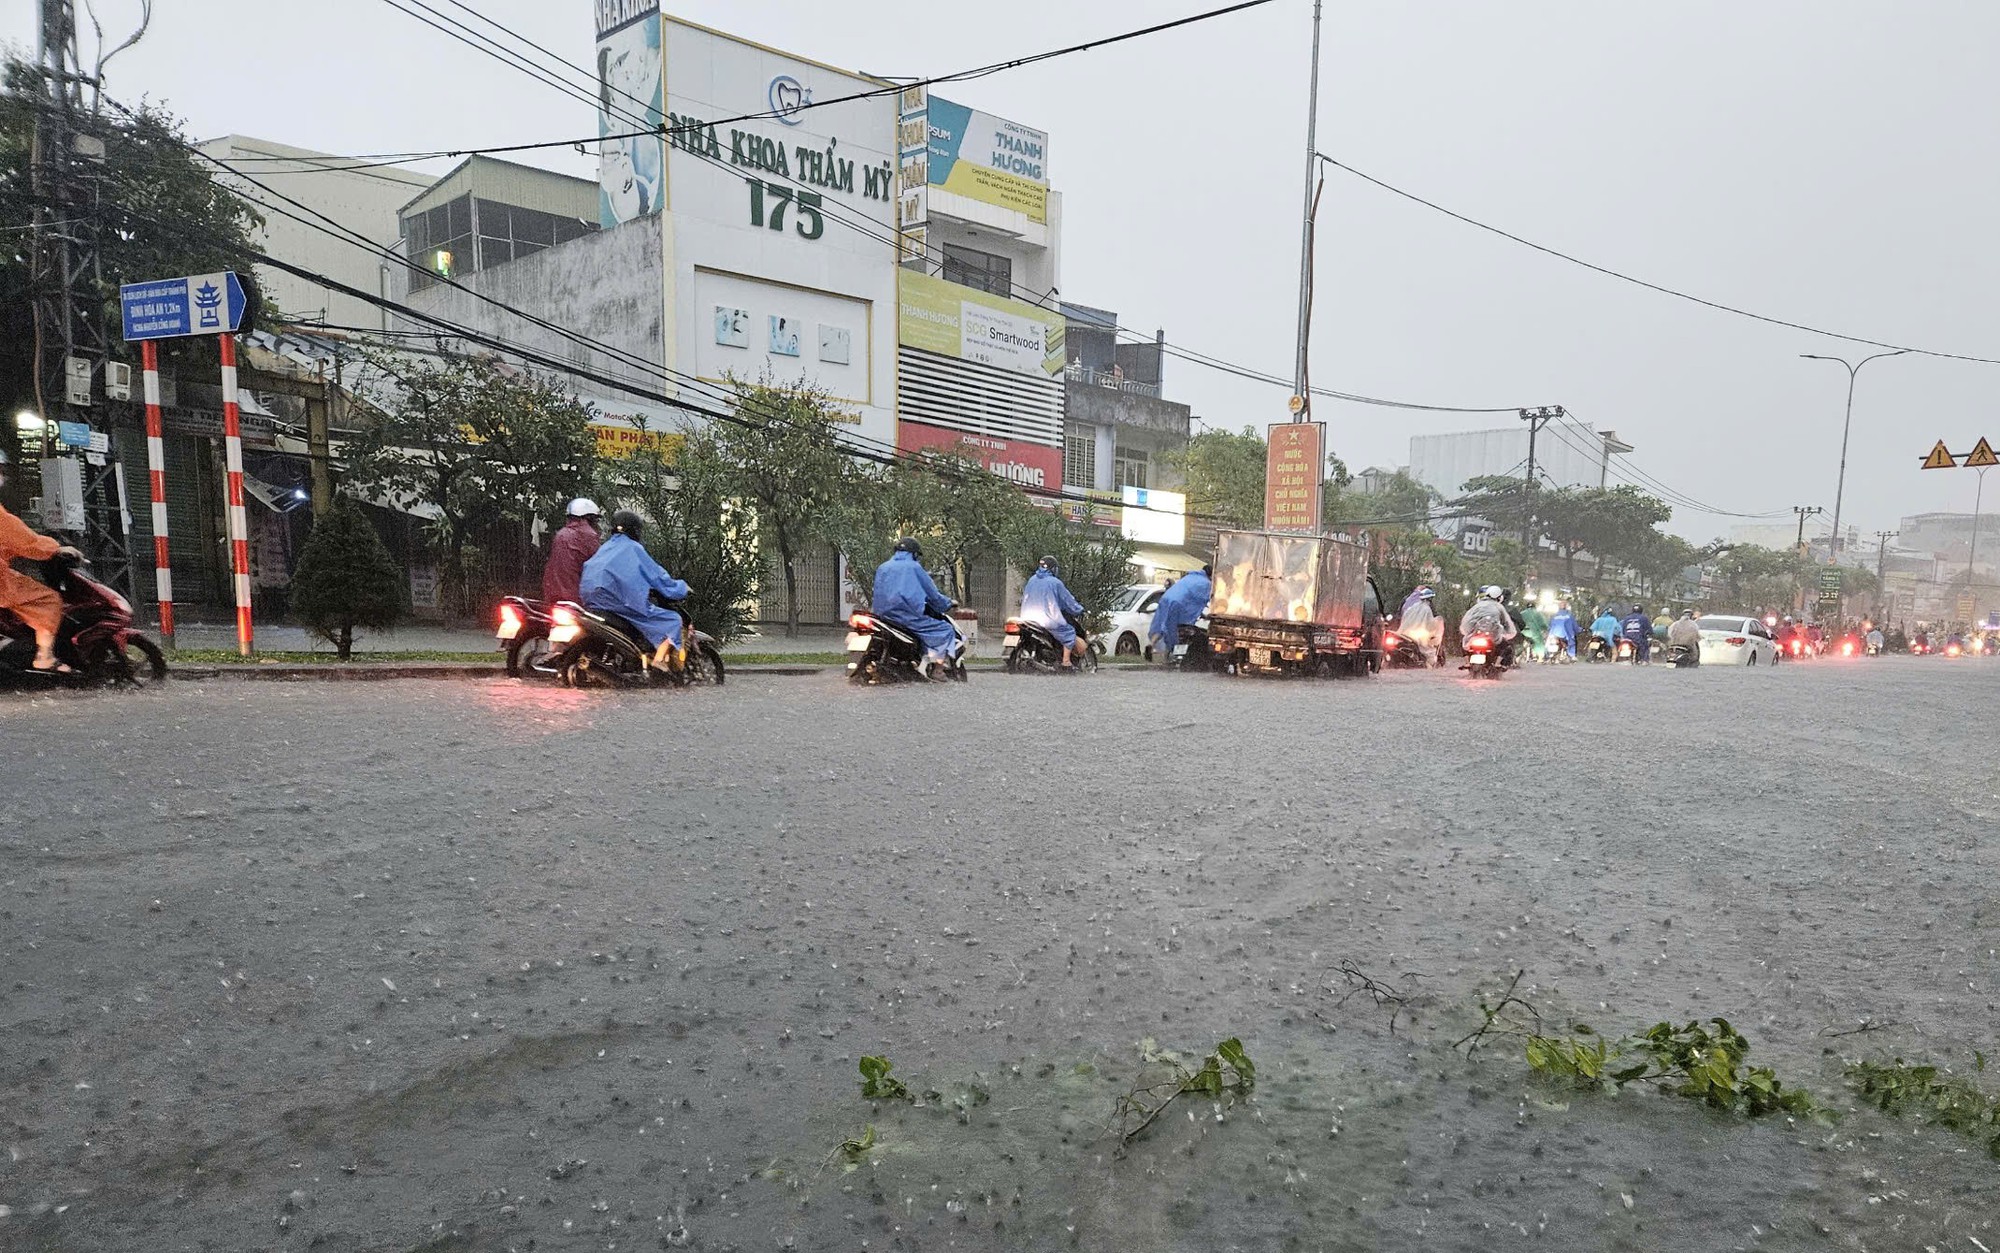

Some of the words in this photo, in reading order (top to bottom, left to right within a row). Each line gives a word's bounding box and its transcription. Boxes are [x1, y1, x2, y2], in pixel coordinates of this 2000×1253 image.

[669, 111, 722, 161] NHA
[730, 128, 790, 177] KHOA
[795, 137, 854, 193] THẨM
[863, 160, 893, 202] MỸ
[995, 130, 1042, 160] THANH
[992, 150, 1042, 180] HƯƠNG
[745, 177, 824, 240] 175
[901, 302, 928, 320] THANH
[928, 310, 959, 329] HƯƠNG
[965, 321, 988, 336] SCG
[989, 326, 1040, 351] Smartwood
[963, 435, 980, 446] CÔNG
[981, 439, 990, 448] TY
[990, 441, 1007, 451] TNHH
[1284, 447, 1303, 459] NƯỚC
[989, 460, 1045, 487] HƯƠNG
[1276, 463, 1294, 474] CỘNG
[1276, 502, 1290, 513] VIỆT
[1291, 503, 1307, 512] NAM
[1463, 527, 1489, 552] ĐỨ
